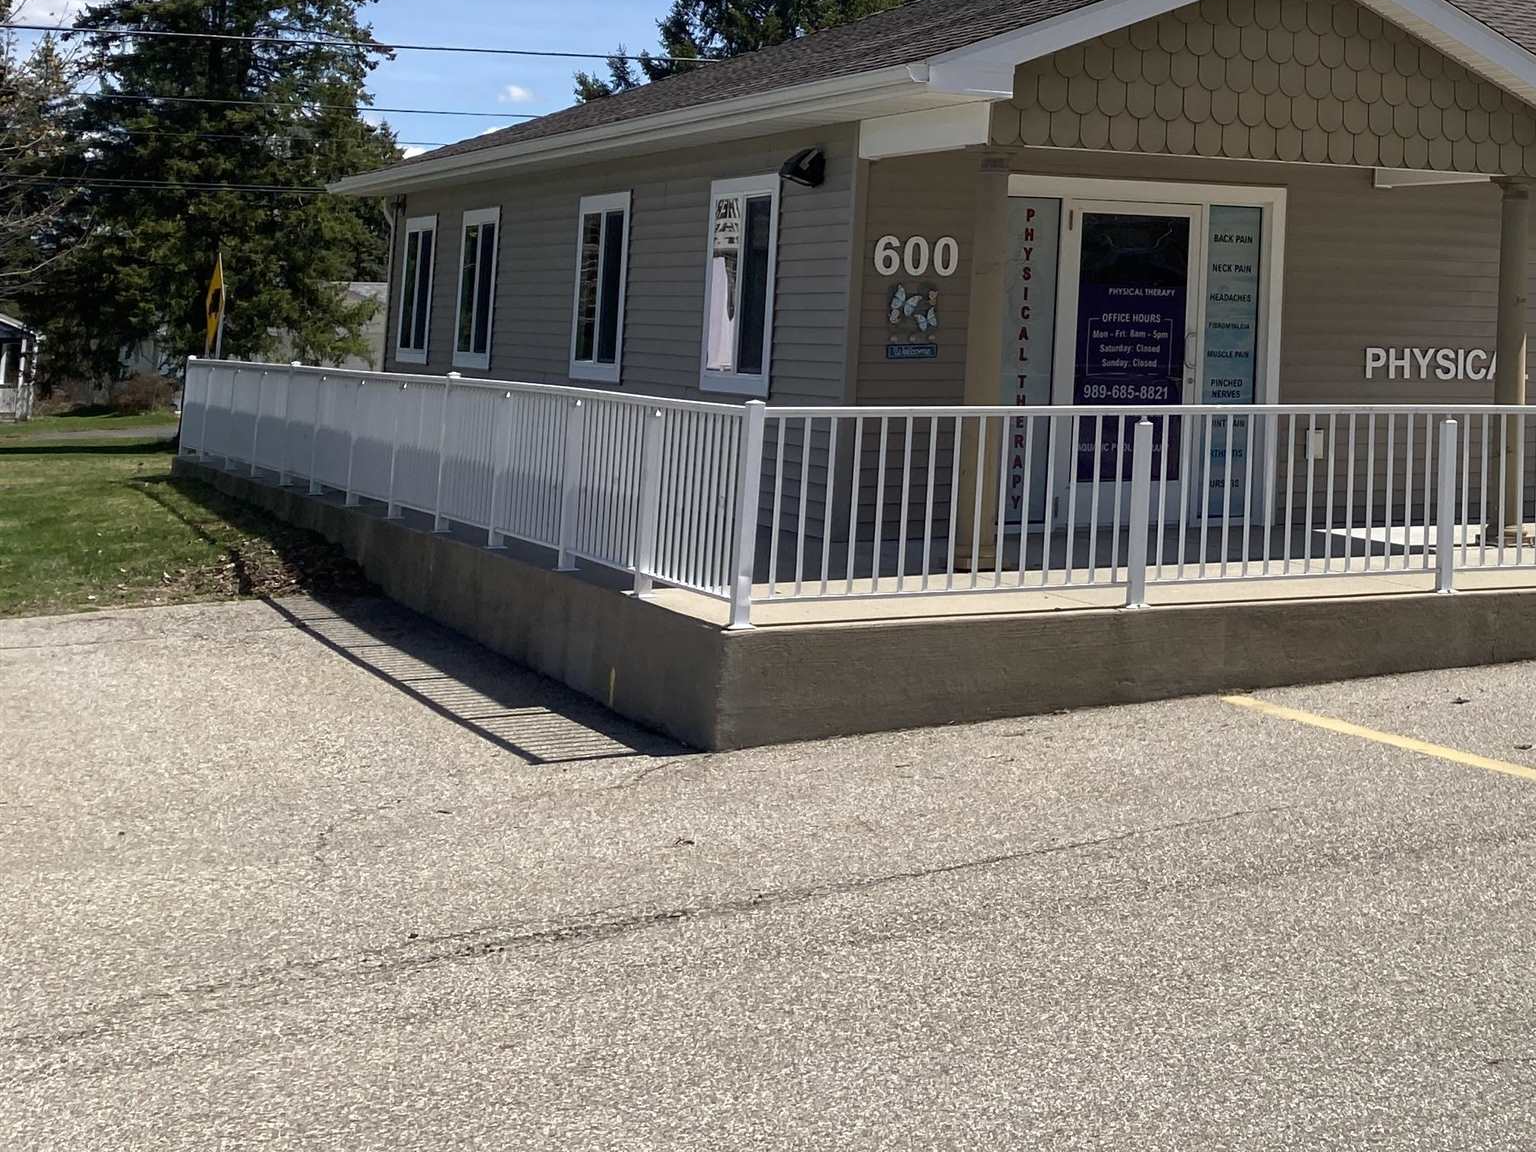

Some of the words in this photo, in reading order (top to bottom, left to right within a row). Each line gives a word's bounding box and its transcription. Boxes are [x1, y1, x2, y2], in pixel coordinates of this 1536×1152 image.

[1214, 234, 1234, 243] BACK
[1235, 235, 1253, 244] PAIN
[874, 235, 959, 277] 600
[1212, 264, 1233, 273] NECK
[1234, 264, 1252, 273] PAIN
[1018, 208, 1036, 361] PHYSICAL
[1108, 288, 1144, 296] PHYSICAL
[1210, 294, 1252, 303] HEADACHES
[1102, 313, 1131, 323] OFFICE
[1132, 314, 1161, 323] HOURS
[1365, 347, 1529, 380] PHYSIC
[1210, 378, 1243, 387] PINCHED
[1083, 385, 1169, 399] 989-685-8821
[1211, 390, 1241, 398] NERVES
